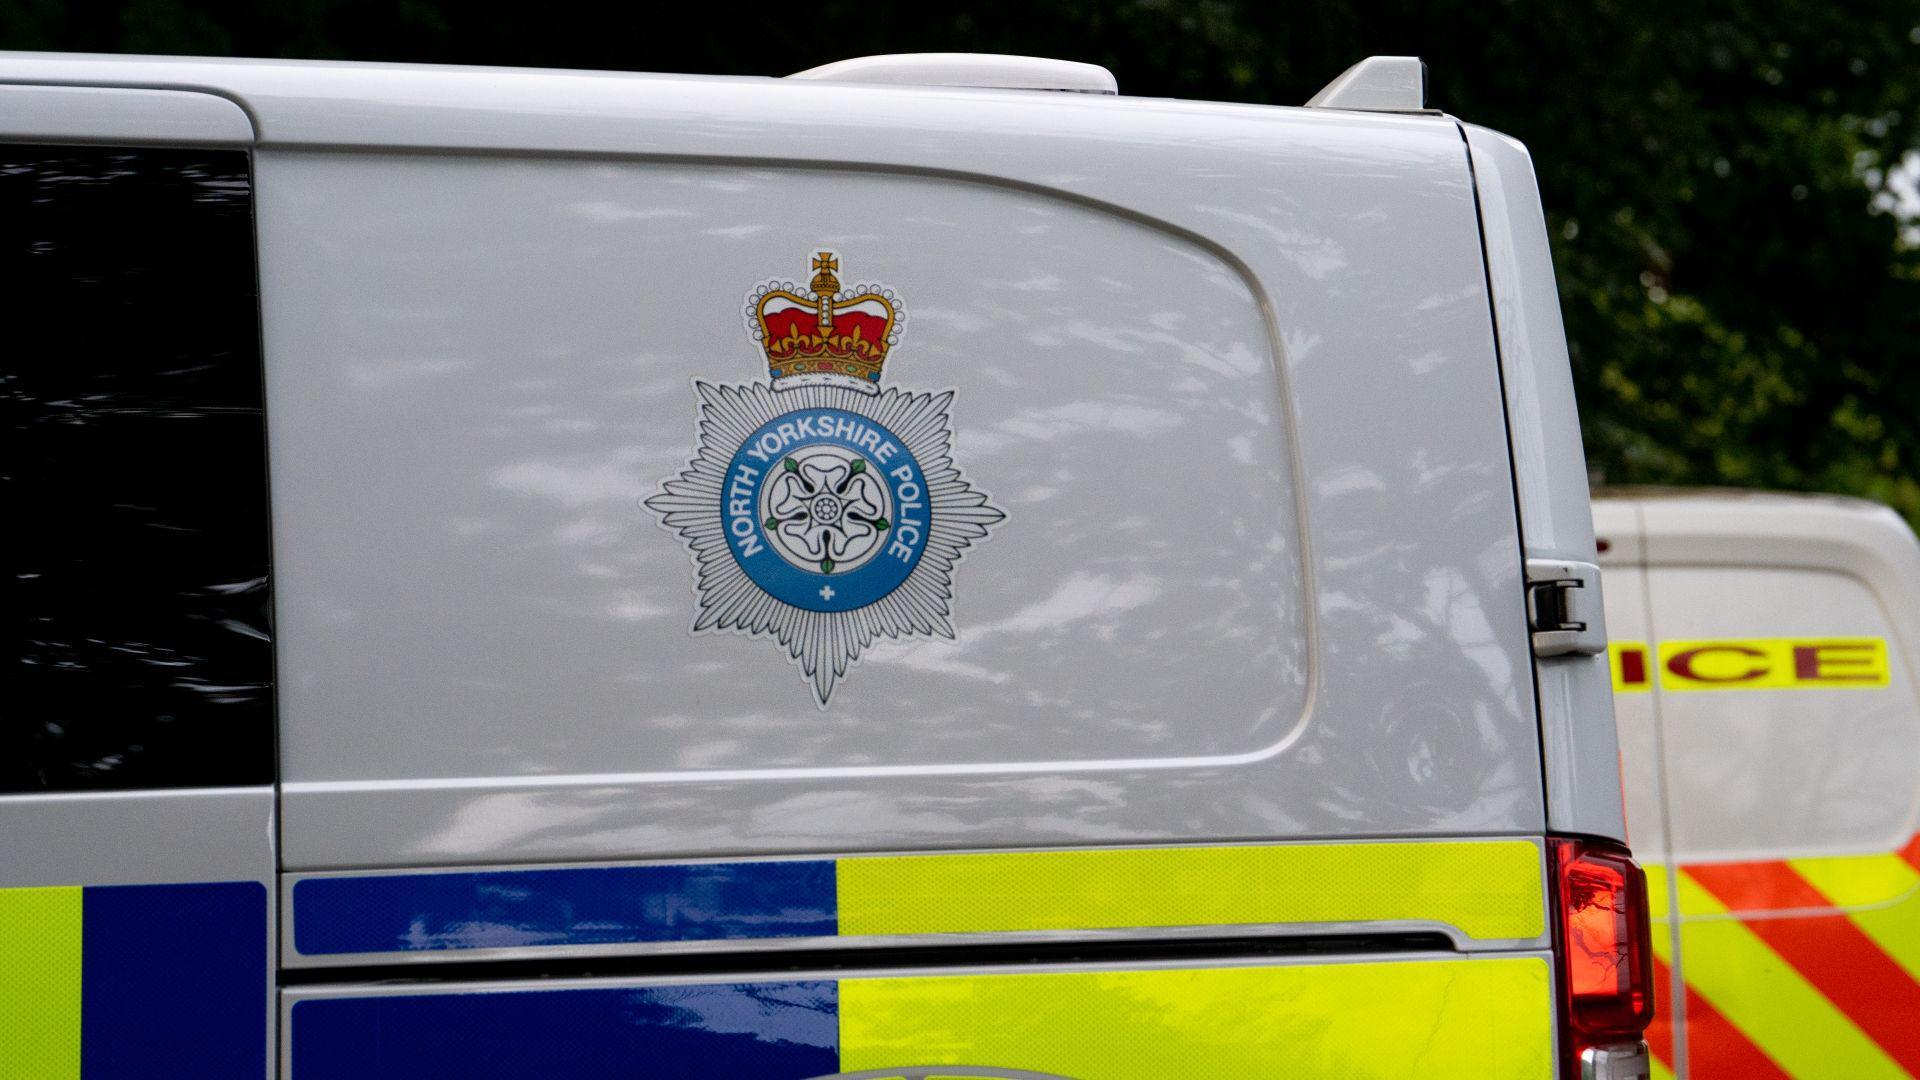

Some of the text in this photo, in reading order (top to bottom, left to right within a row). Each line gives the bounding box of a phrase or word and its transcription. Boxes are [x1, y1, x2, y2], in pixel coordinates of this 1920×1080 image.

[729, 415, 922, 563] NORTH YORKSHIRE POLICE
[1619, 645, 1881, 684] ICE
